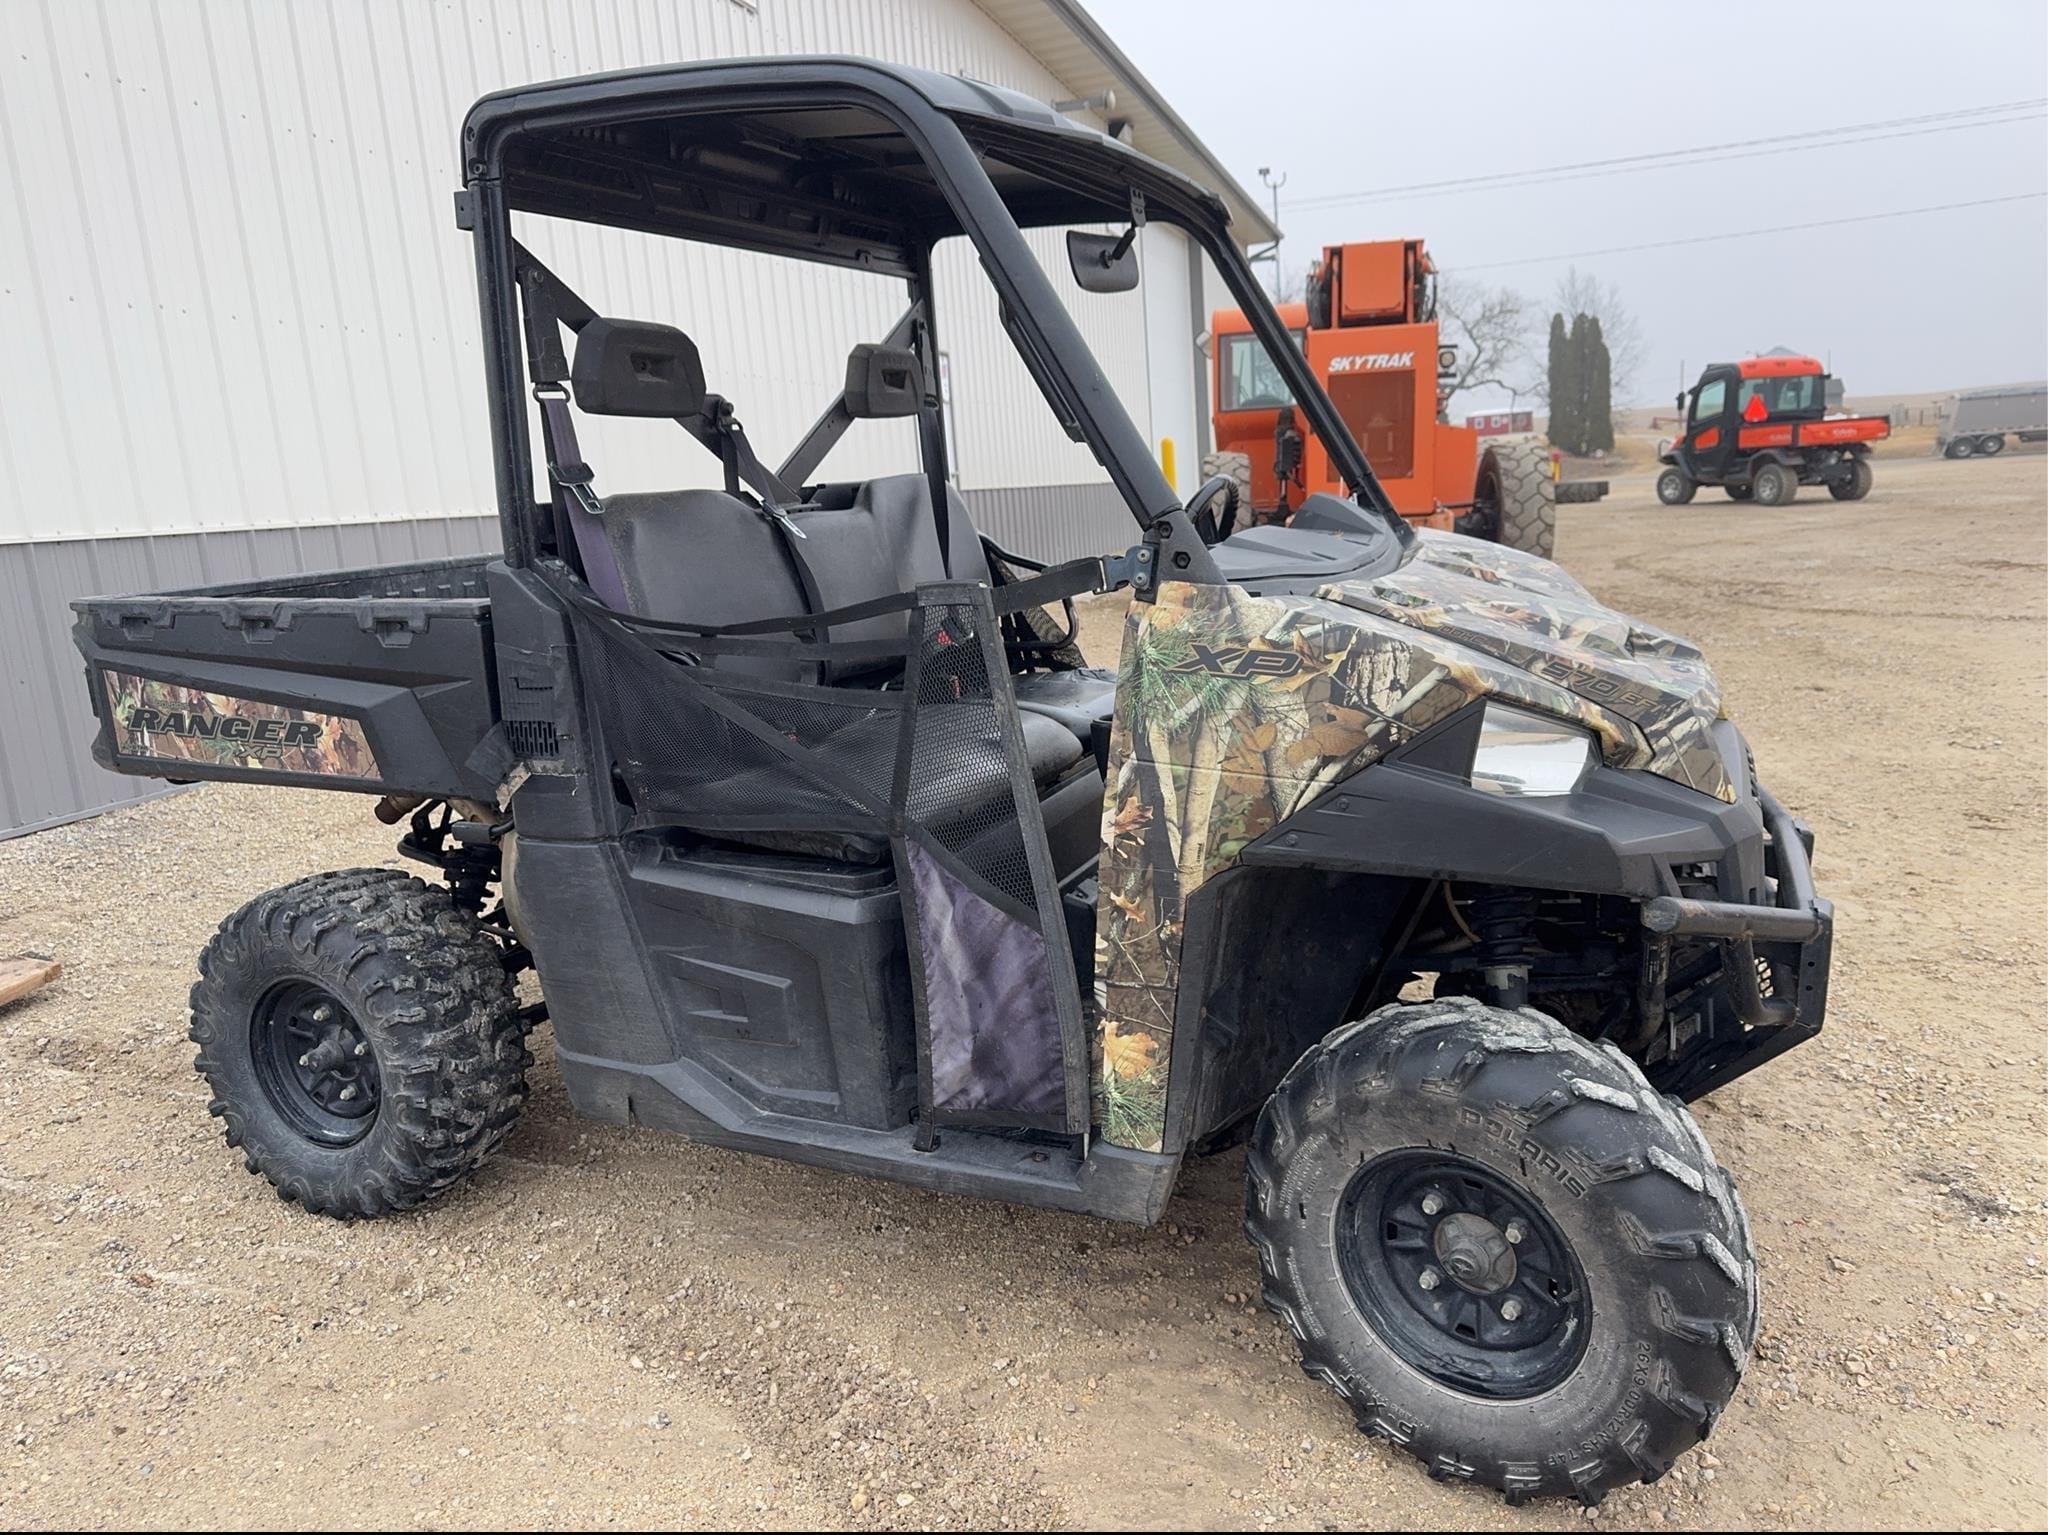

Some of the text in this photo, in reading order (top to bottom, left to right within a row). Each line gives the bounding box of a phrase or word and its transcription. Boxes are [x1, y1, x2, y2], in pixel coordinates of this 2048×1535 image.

[1327, 351, 1415, 372] SKYTRAK
[1162, 641, 1304, 680] XP
[1541, 661, 1621, 697] 570
[127, 707, 324, 748] RANGER
[237, 744, 283, 760] XP
[1459, 1106, 1589, 1199] POLARIS
